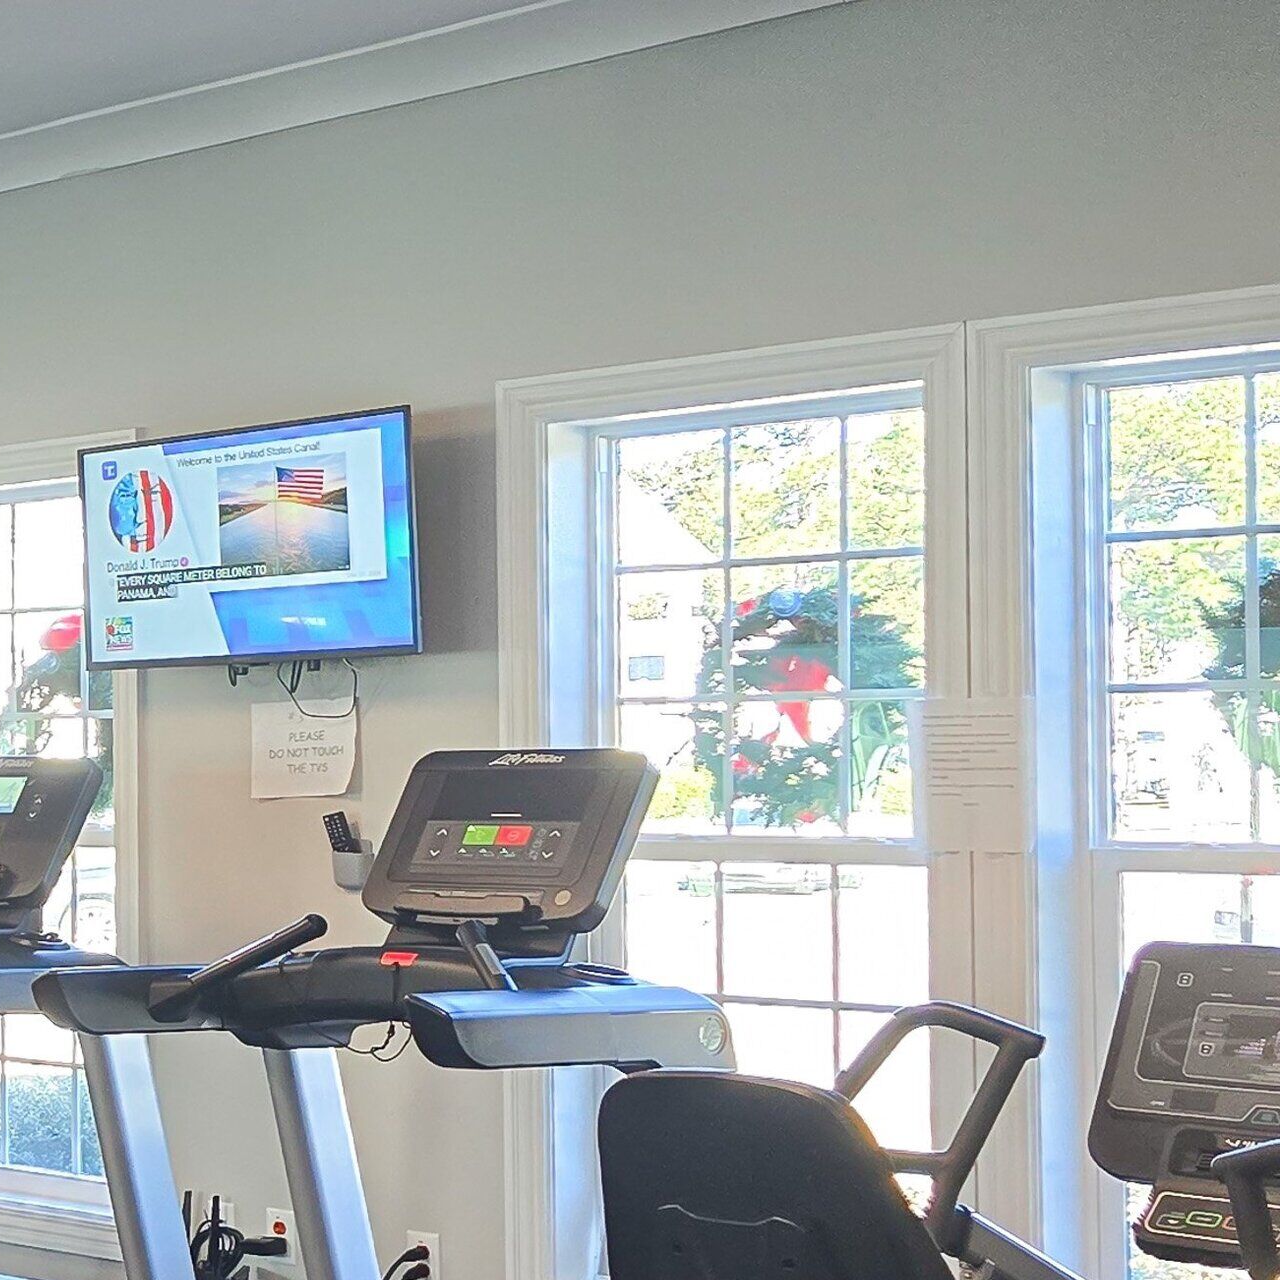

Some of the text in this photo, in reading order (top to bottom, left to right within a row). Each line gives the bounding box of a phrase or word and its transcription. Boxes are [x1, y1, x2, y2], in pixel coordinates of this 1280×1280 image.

[177, 456, 212, 468] Welcome
[214, 454, 223, 464] to
[224, 453, 236, 462] the
[239, 448, 264, 460] United
[267, 445, 292, 457] States
[107, 557, 178, 573] Donald J. Trump
[148, 571, 182, 585] SQUARE
[184, 569, 214, 582] METER
[216, 565, 251, 579] BELONG
[254, 564, 266, 576] TO
[289, 730, 325, 742] PLEASE
[269, 746, 344, 759] DO NOT TOUCH
[287, 763, 306, 774] THE
